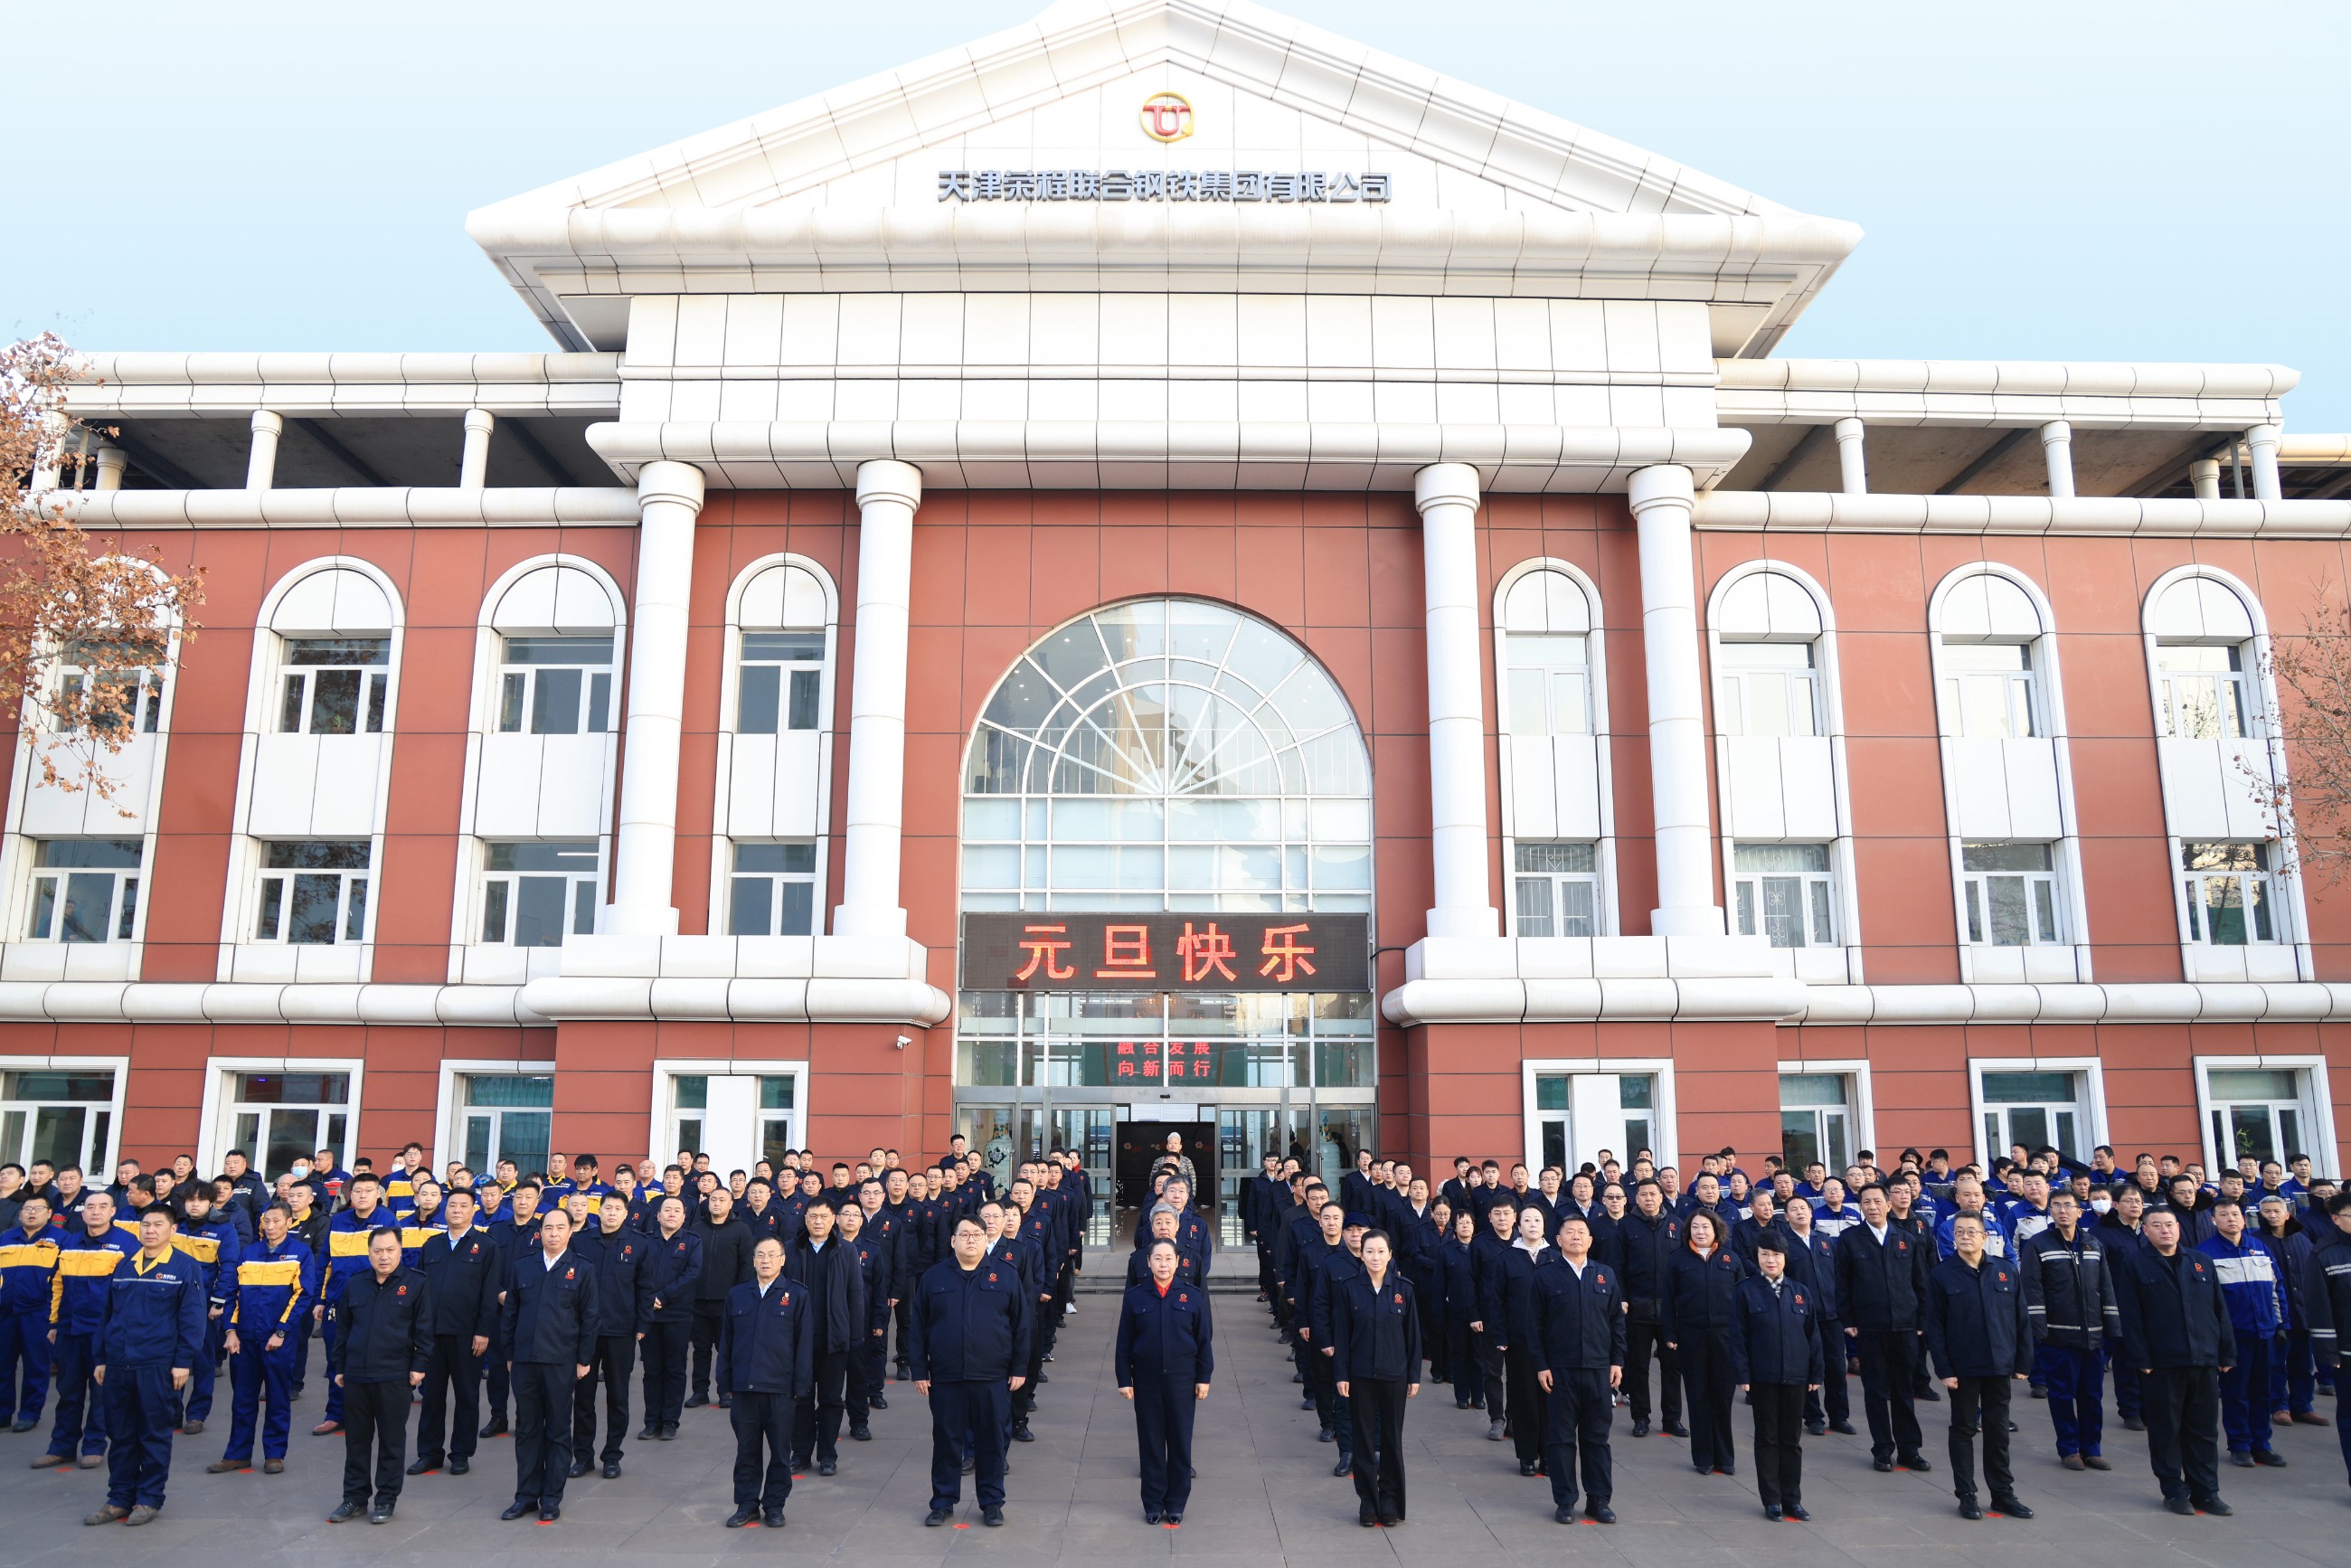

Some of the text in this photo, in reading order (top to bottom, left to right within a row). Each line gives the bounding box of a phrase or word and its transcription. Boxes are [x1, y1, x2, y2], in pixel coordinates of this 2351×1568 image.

[938, 169, 1393, 203] 天津荣程联合钢铁集团有限公司
[1015, 921, 1317, 983] 元旦快乐
[1118, 1042, 1210, 1055] 融合发展
[1118, 1060, 1211, 1077] 向新而行
